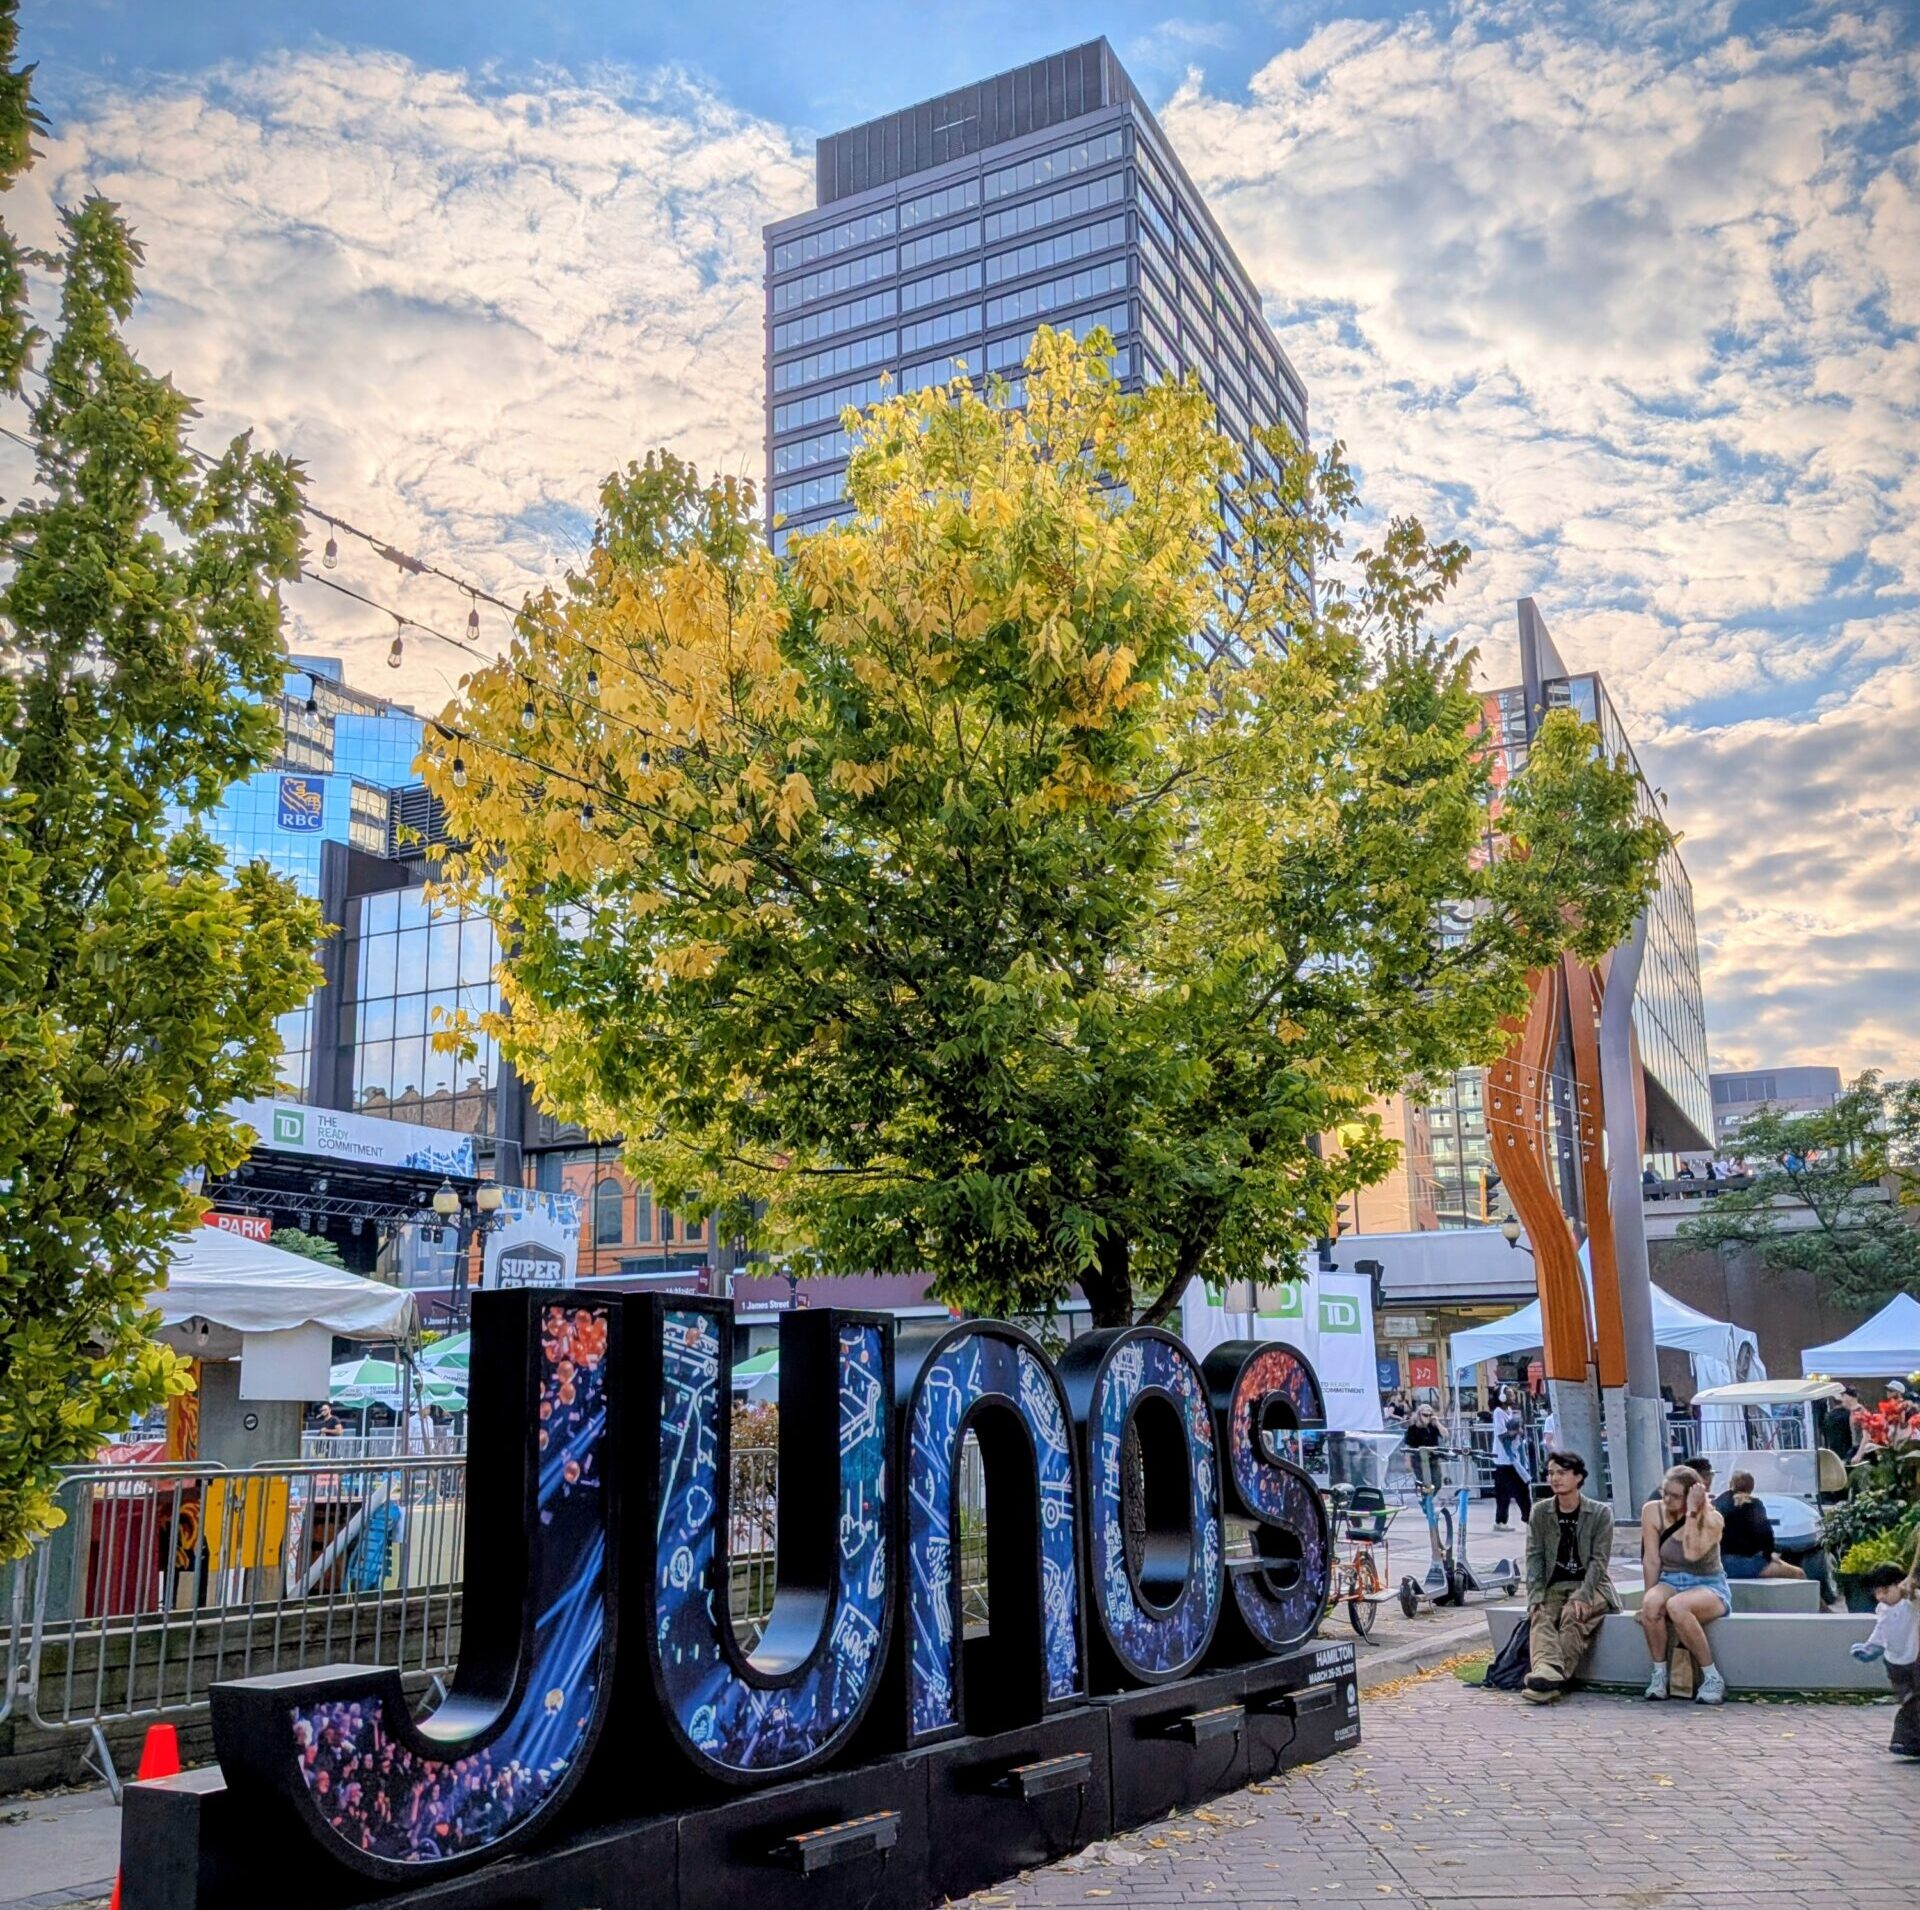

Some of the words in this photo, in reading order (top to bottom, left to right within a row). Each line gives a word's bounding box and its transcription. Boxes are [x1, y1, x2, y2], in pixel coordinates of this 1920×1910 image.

[282, 813, 320, 828] RBC
[276, 1115, 301, 1138] TD
[318, 1115, 338, 1128] THE
[318, 1127, 349, 1141] READY
[318, 1138, 384, 1158] COMMITMENT
[218, 1216, 267, 1239] PARK
[501, 1258, 561, 1280] SUPER
[741, 1301, 746, 1311] 1
[746, 1301, 769, 1310] James
[769, 1299, 790, 1309] Street
[1320, 1301, 1356, 1327] TD
[1316, 1644, 1354, 1667] HAMILTON
